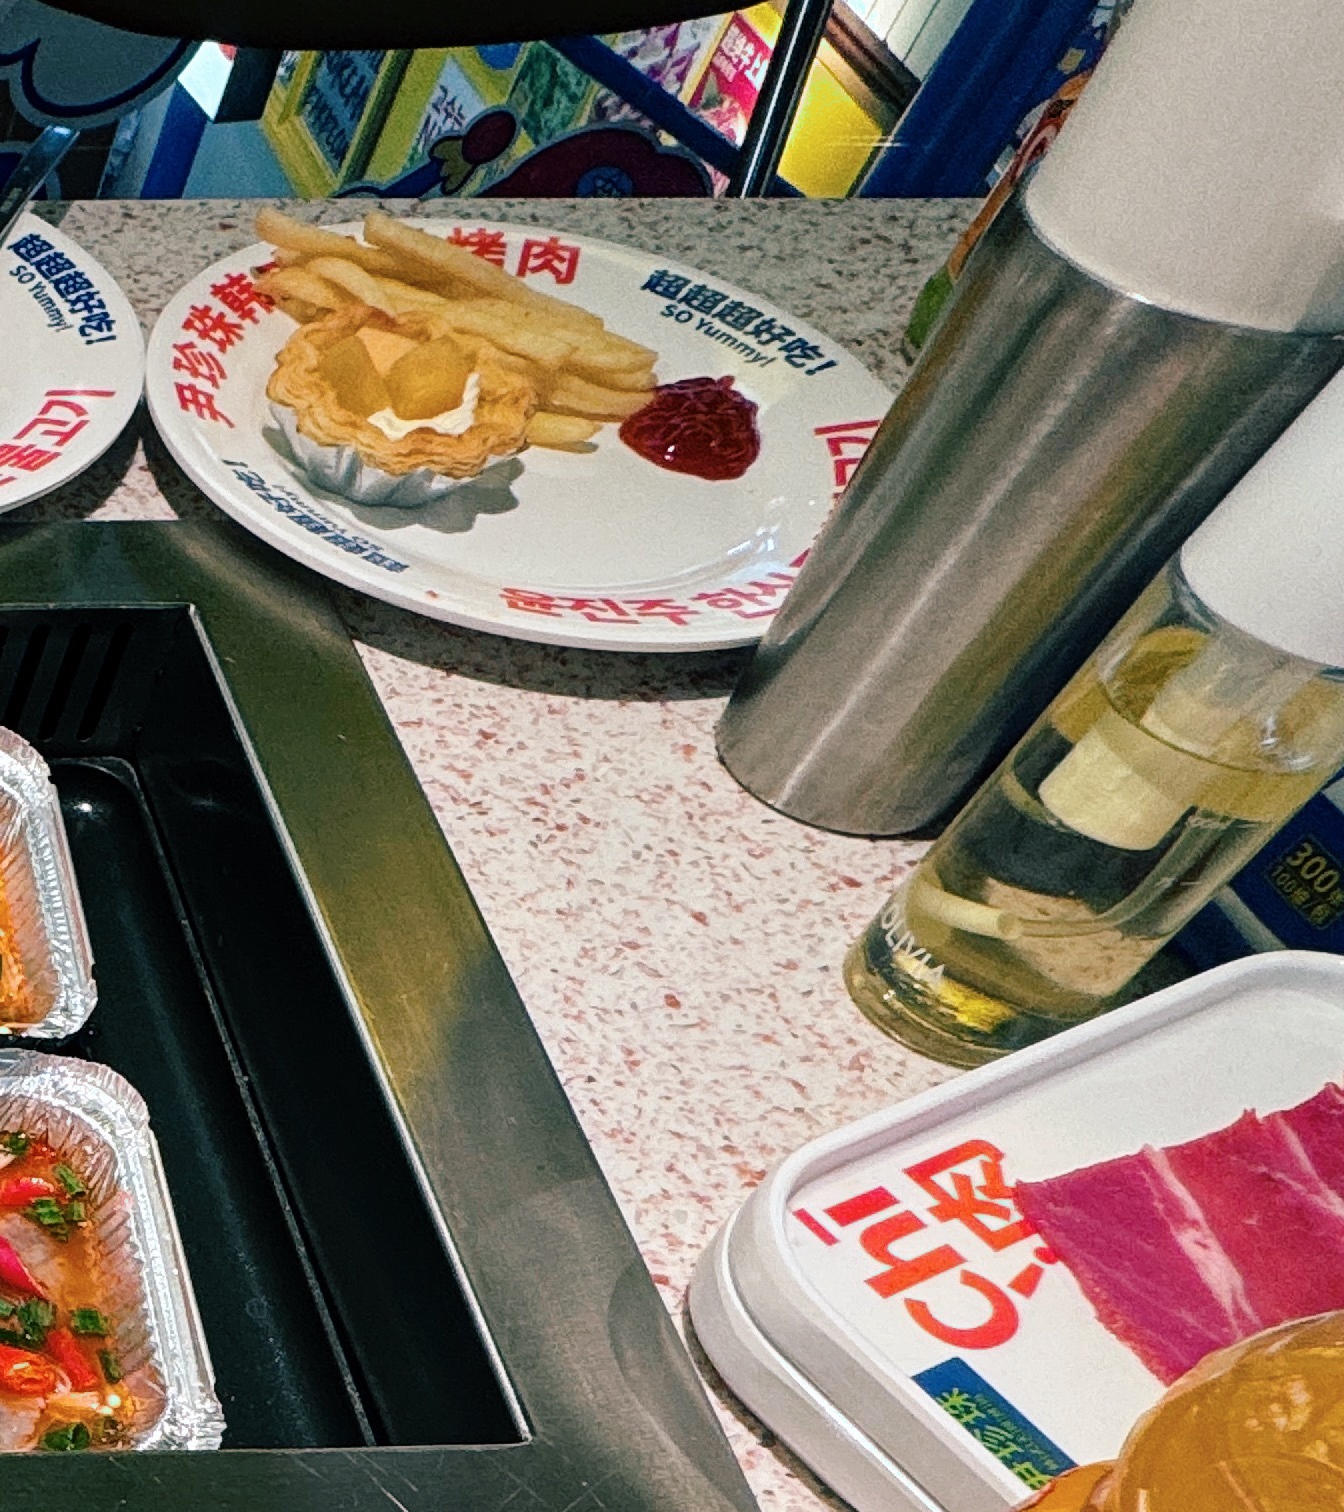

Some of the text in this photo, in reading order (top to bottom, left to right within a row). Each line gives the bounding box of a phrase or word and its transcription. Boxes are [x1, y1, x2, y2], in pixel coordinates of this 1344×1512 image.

[7, 233, 117, 346] 超超超好吃!
[640, 268, 838, 376] 超超超好吃!
